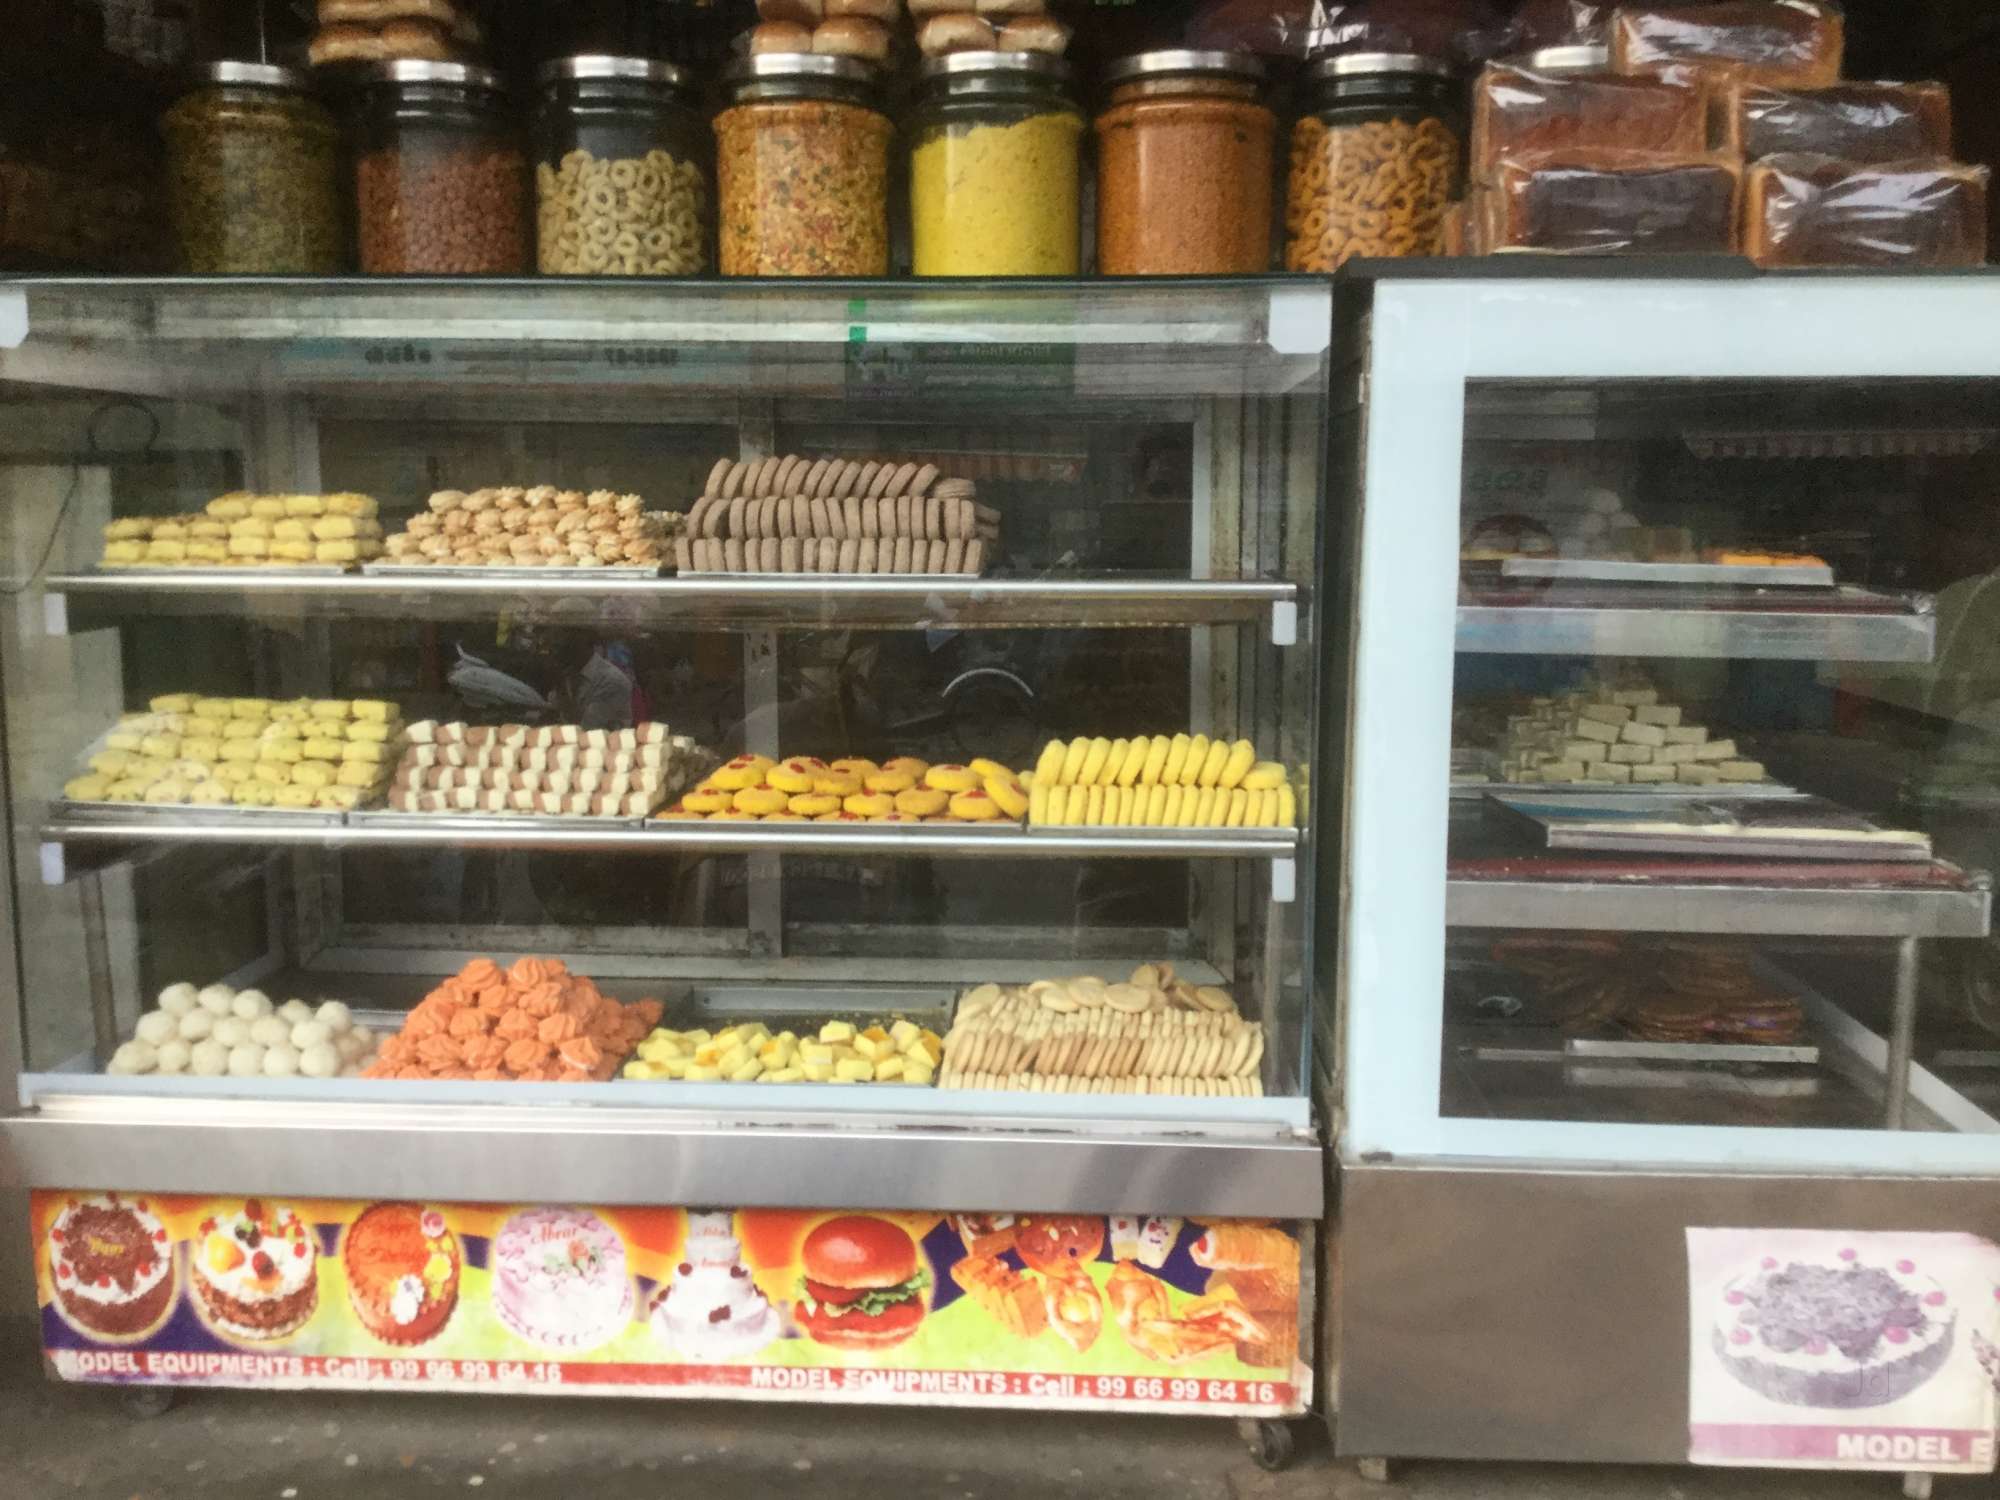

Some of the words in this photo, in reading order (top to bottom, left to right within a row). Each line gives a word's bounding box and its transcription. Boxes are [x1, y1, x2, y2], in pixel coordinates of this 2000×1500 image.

[147, 1353, 303, 1376] EQUIPMENTS
[391, 1359, 419, 1379] 99
[461, 1361, 490, 1380] 99
[751, 1368, 838, 1388] MODEL
[1028, 1374, 1075, 1396] Cell
[1097, 1377, 1126, 1397] 99
[1133, 1378, 1163, 1398] 66
[1171, 1379, 1200, 1399] 99
[1207, 1381, 1236, 1401] 64
[1245, 1382, 1275, 1402] 16
[1837, 1434, 1961, 1461] MODEL
